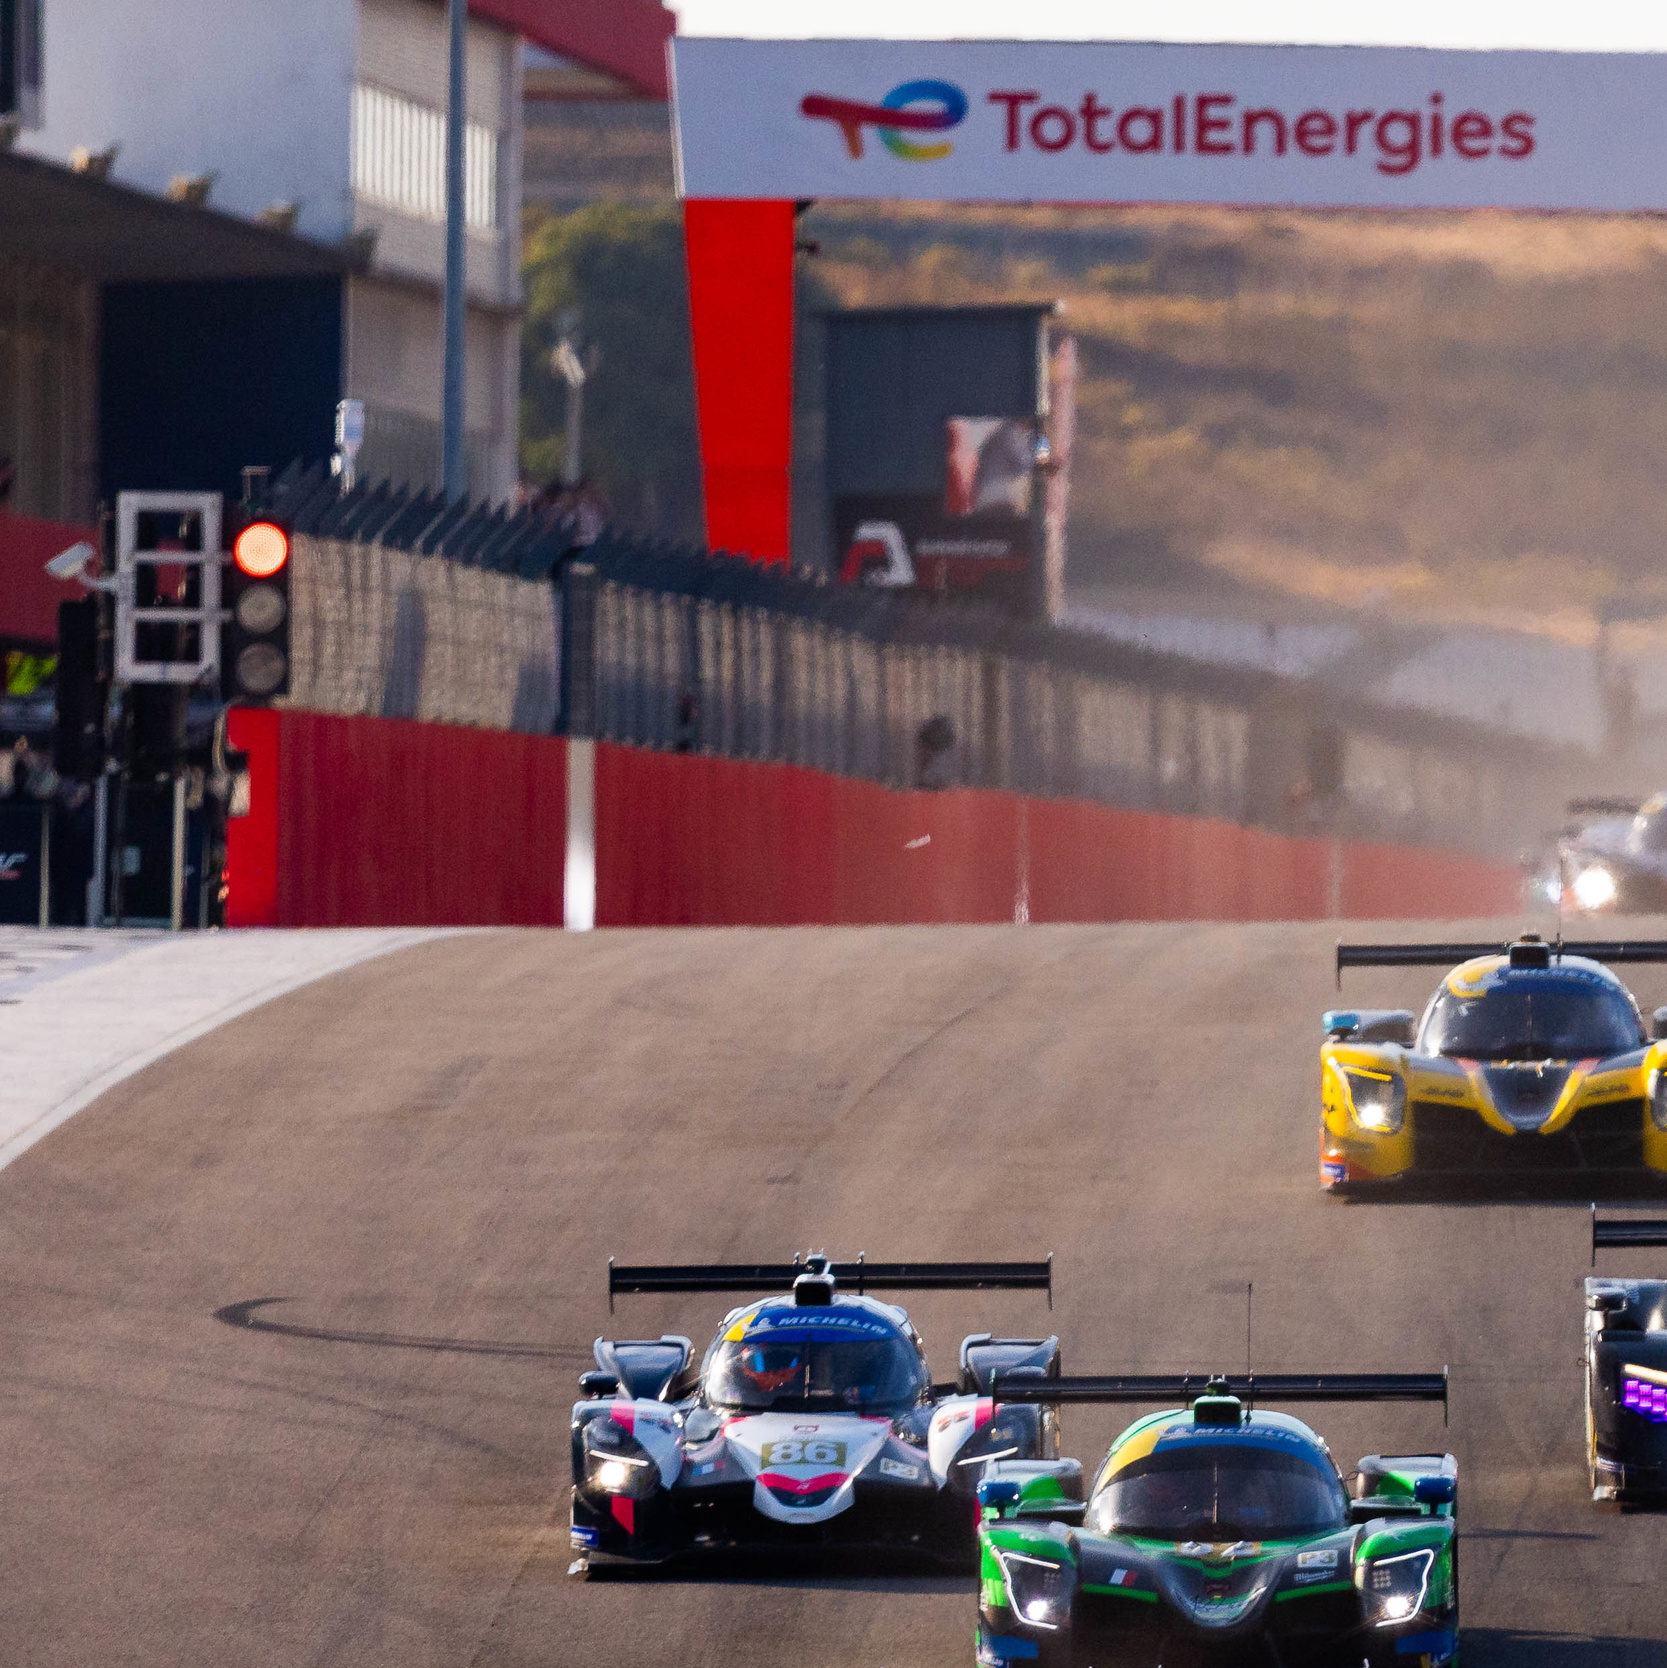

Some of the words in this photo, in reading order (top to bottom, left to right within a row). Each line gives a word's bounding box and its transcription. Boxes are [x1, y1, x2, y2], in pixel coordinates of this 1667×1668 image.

[989, 92, 1536, 176] TotalEnergies
[779, 1316, 888, 1335] MICHELIN
[768, 1441, 838, 1464] 86
